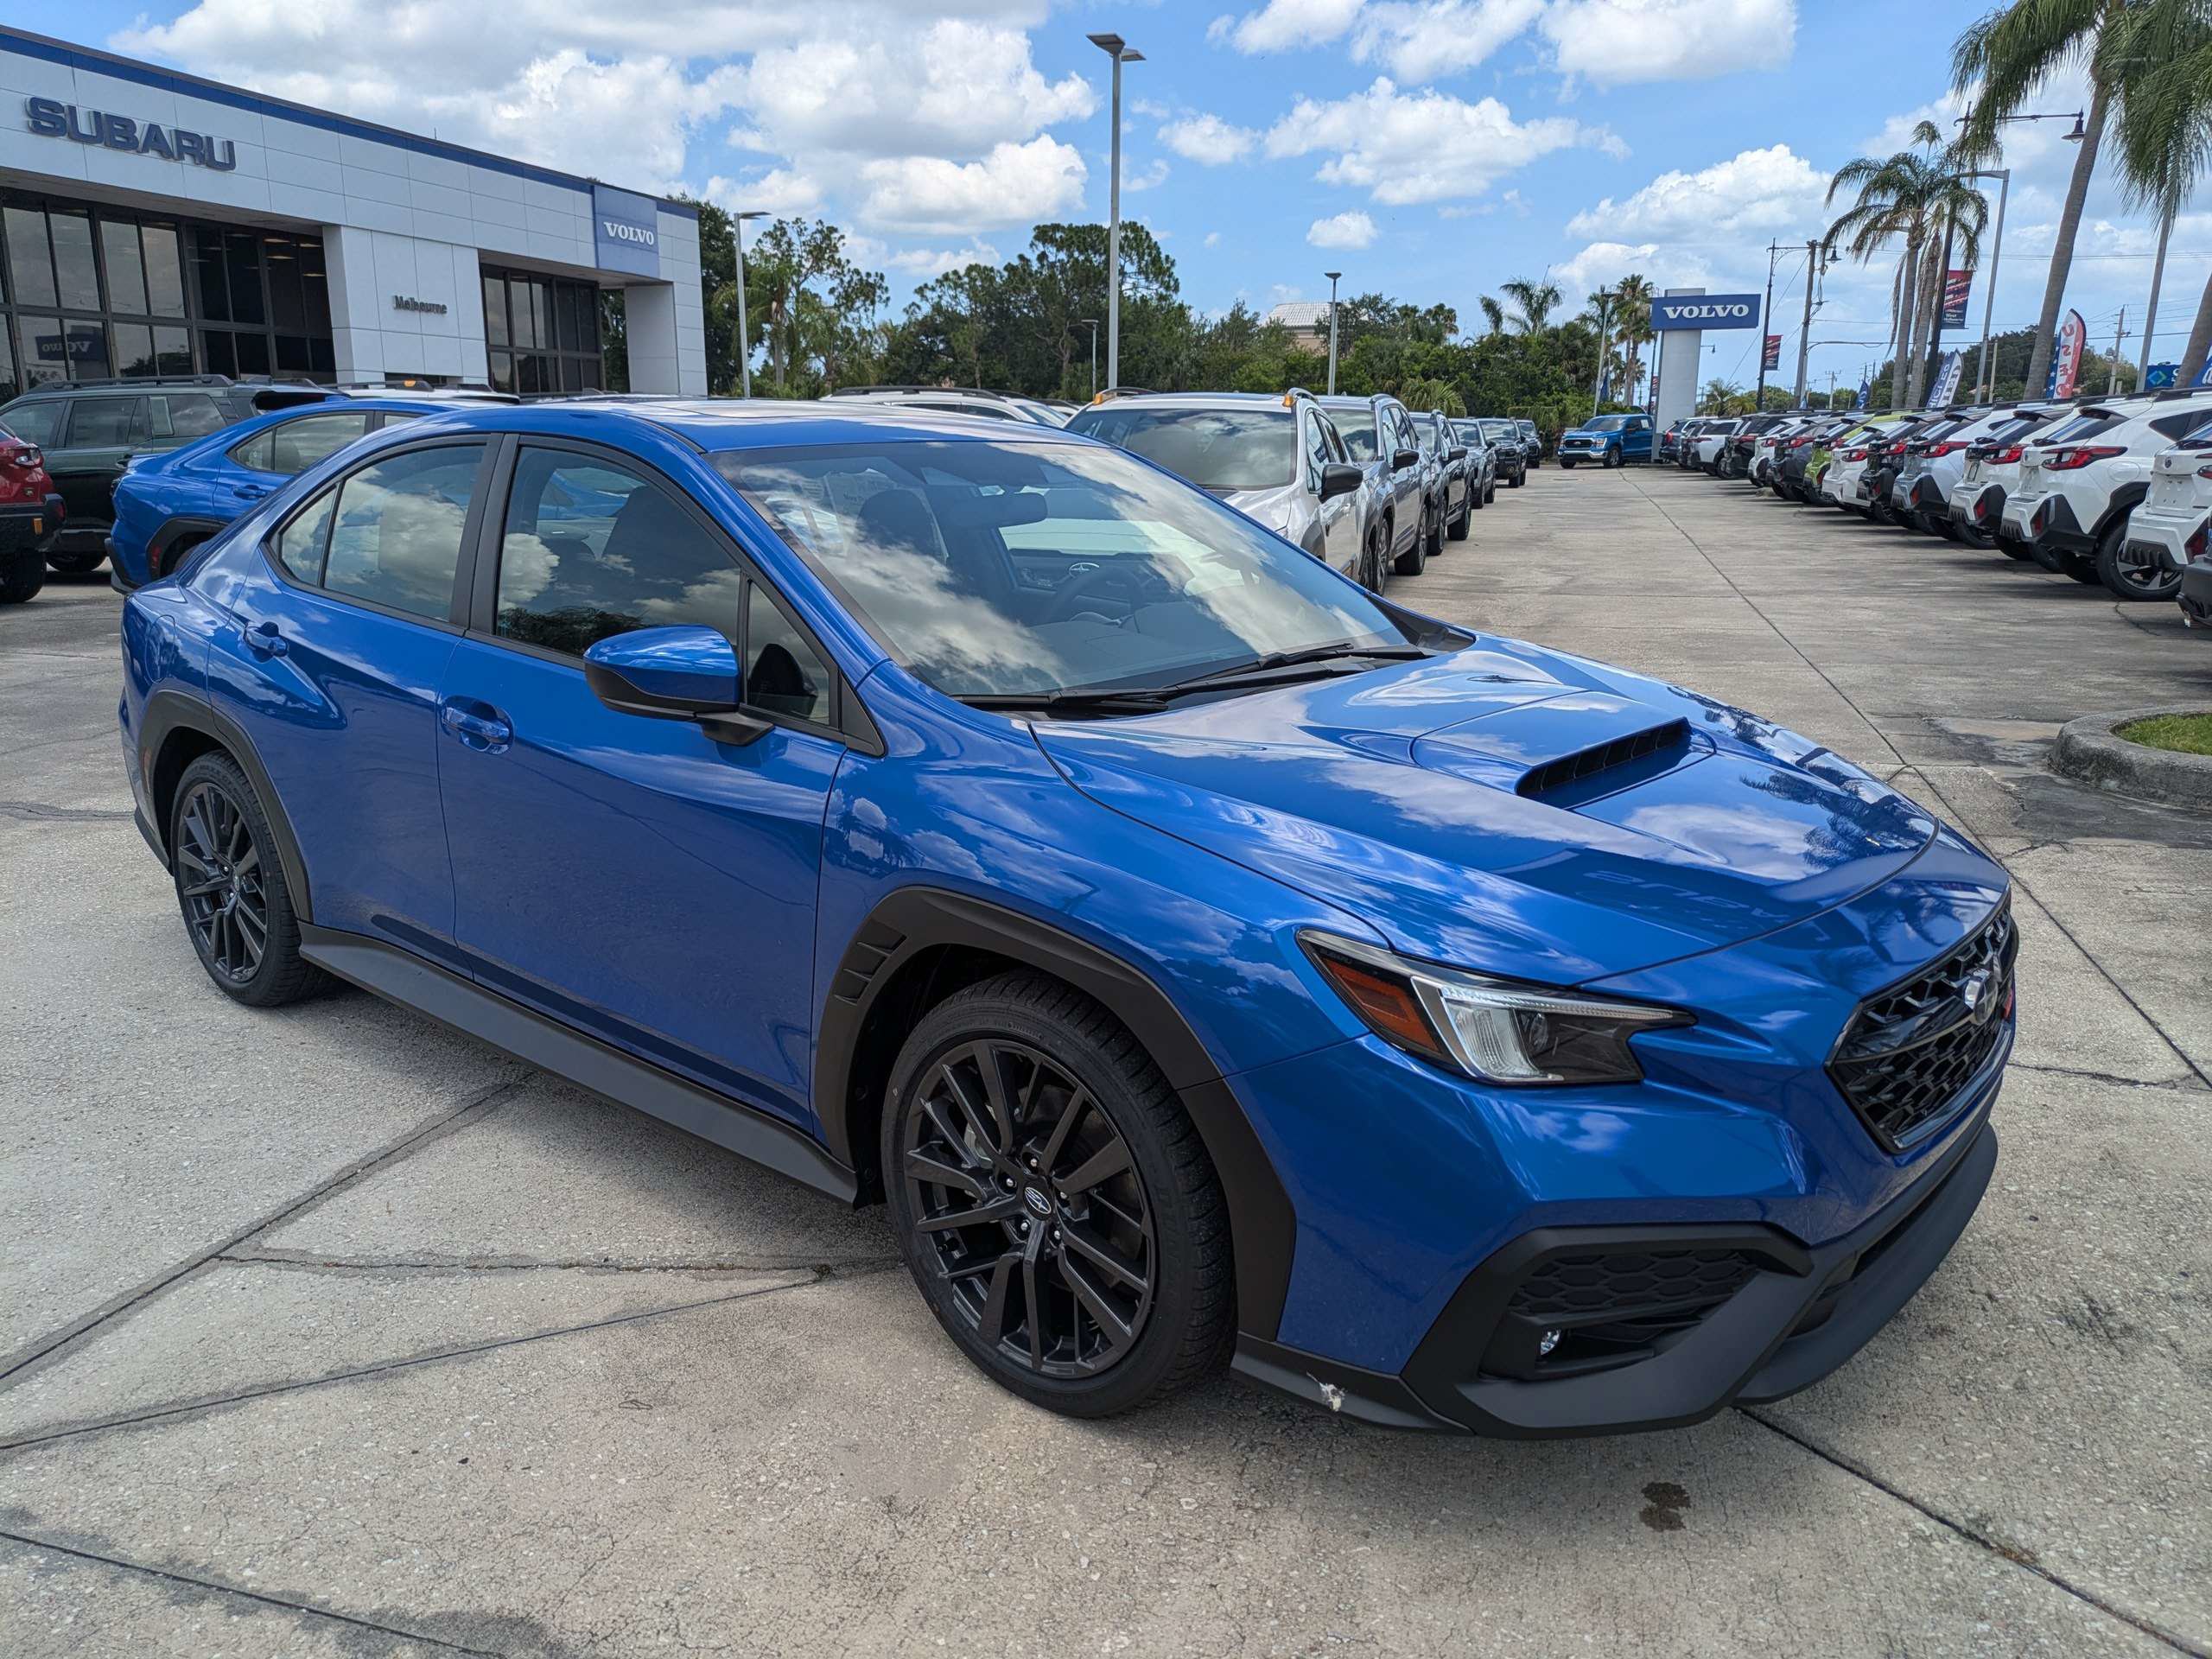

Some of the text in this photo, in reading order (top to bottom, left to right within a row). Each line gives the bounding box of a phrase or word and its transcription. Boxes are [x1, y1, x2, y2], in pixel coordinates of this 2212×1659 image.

[26, 97, 236, 171] SUBARU
[603, 221, 655, 246] VOLVO
[393, 295, 448, 315] Melbourne
[1662, 304, 1750, 319] VOLVO
